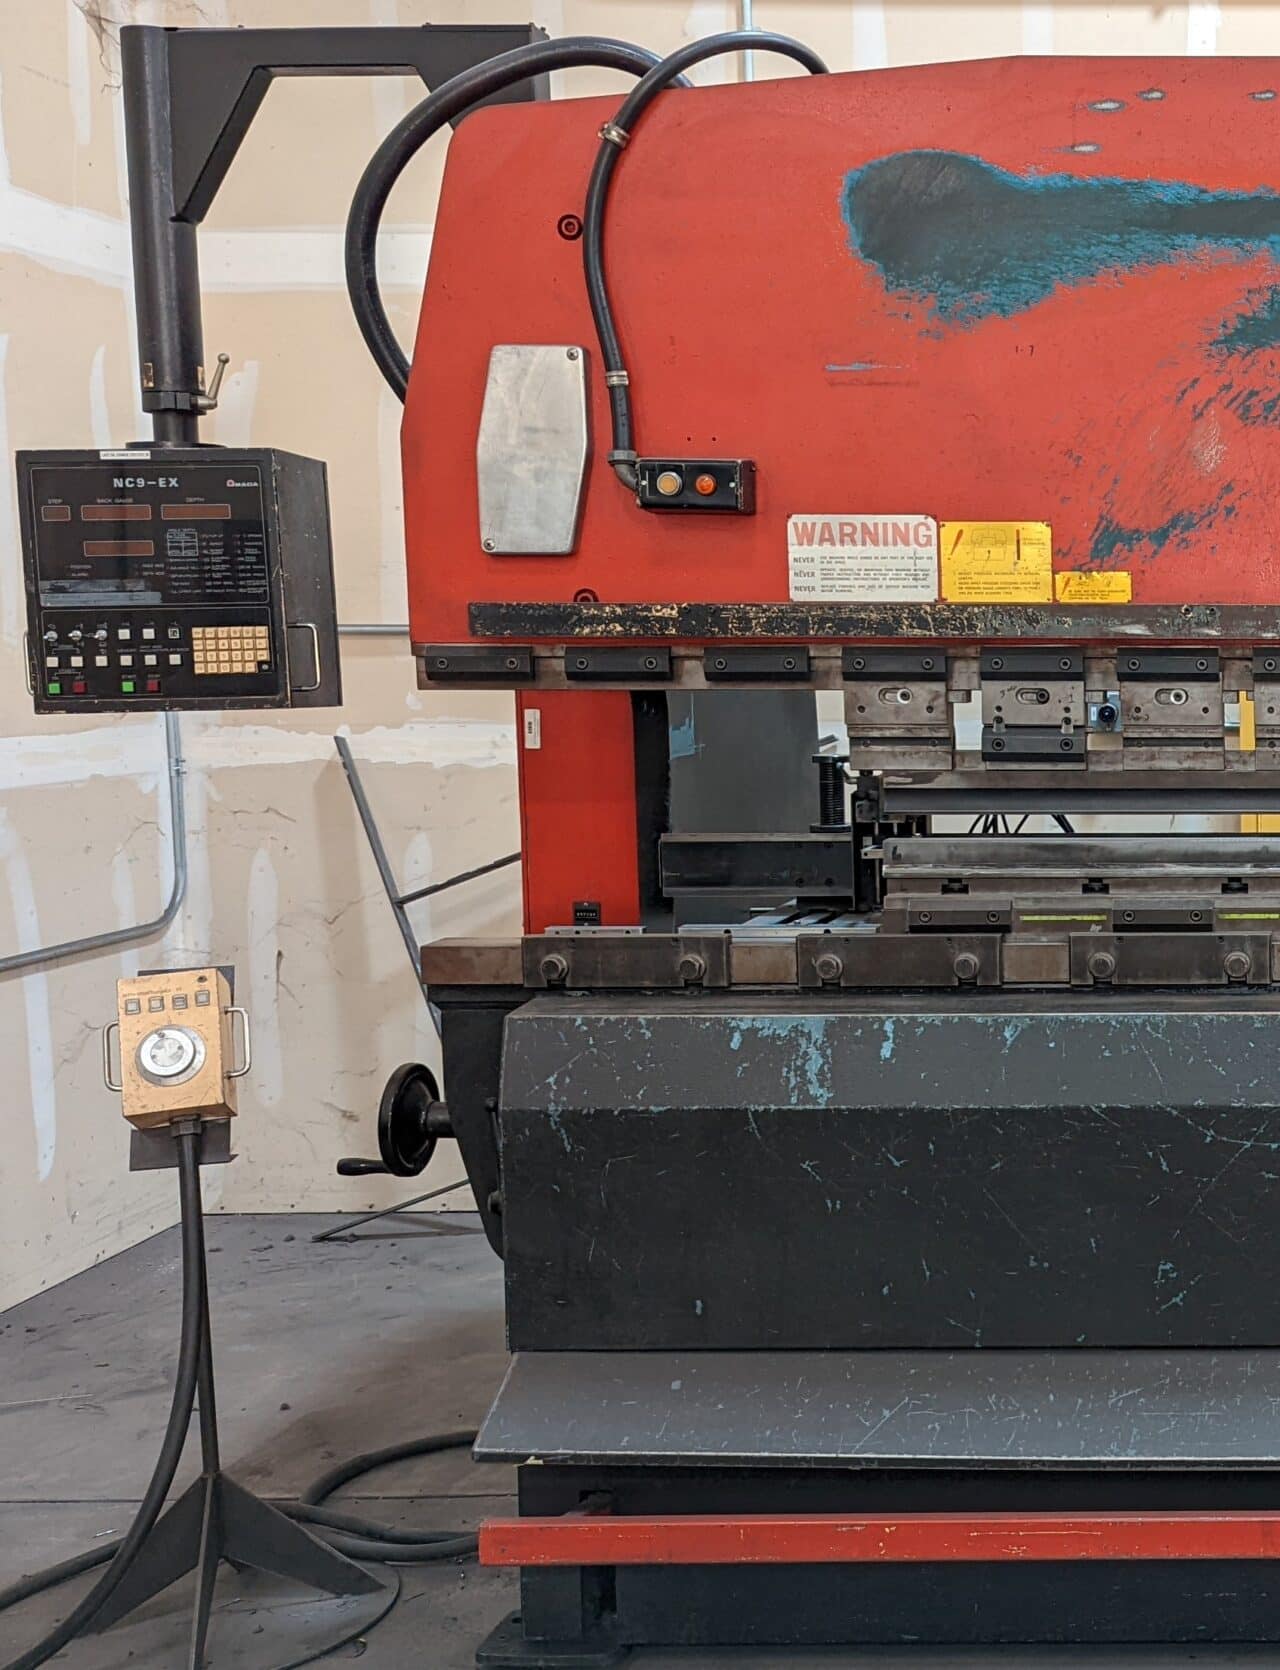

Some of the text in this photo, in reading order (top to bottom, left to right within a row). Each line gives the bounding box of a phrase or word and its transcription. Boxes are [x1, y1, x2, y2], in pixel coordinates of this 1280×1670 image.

[112, 477, 180, 489] NC9-EX
[792, 521, 933, 548] WARNING
[793, 556, 815, 564] NEVER
[794, 585, 816, 593] NEVER
